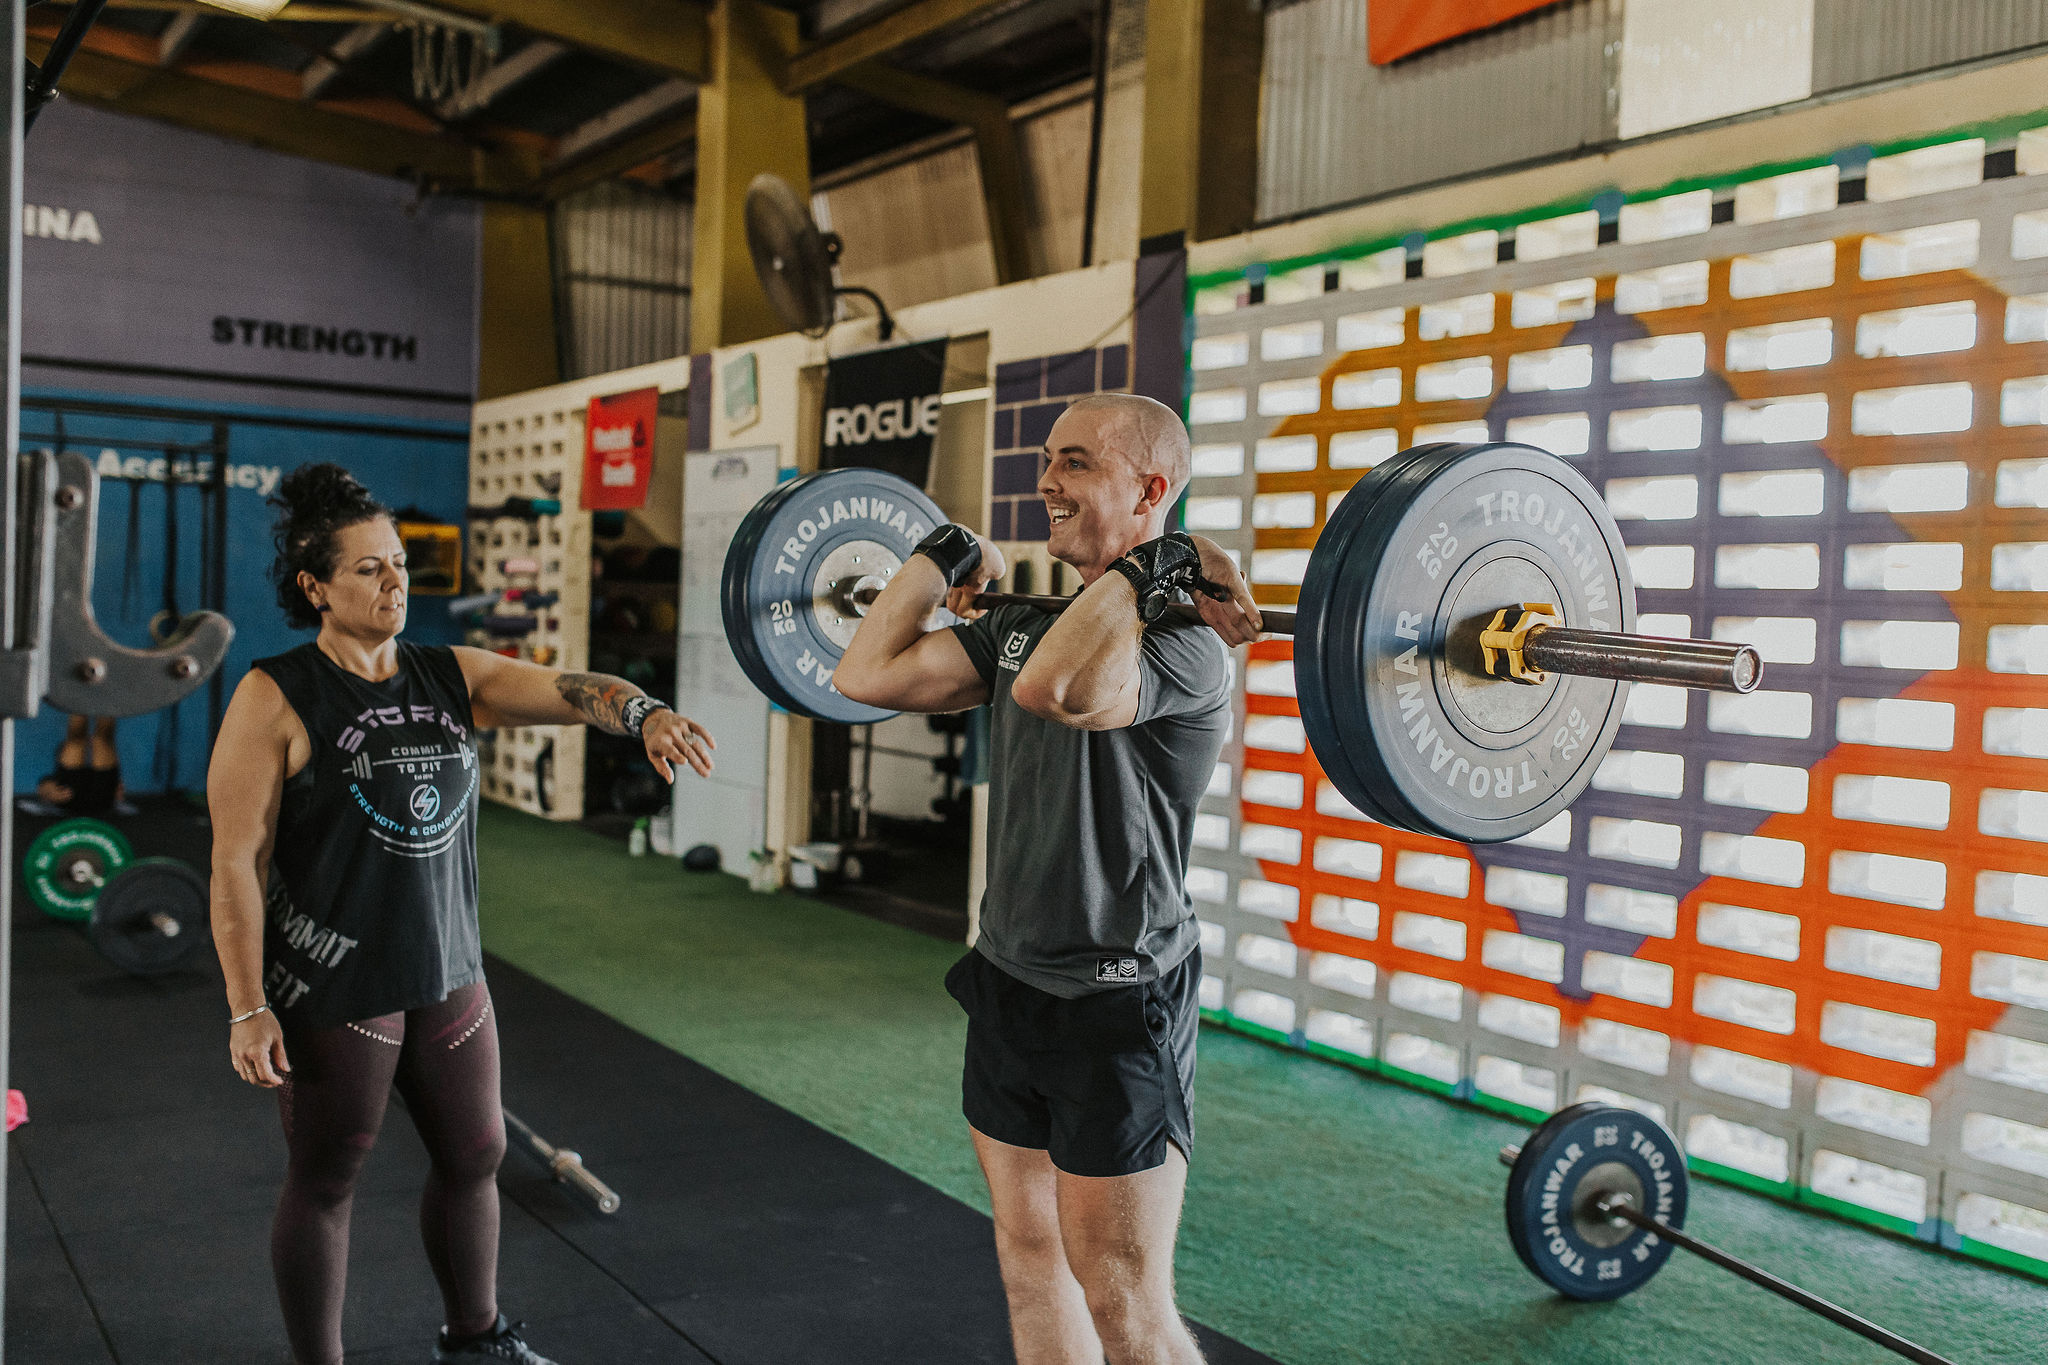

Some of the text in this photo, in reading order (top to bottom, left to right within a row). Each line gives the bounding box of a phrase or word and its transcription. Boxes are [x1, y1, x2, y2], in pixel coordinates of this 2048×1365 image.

[212, 315, 417, 361] STRENGTH
[824, 394, 940, 447] ROGUE
[774, 497, 925, 576] TROJANWAR
[1429, 521, 1458, 560] 20
[1416, 542, 1442, 580] KG
[1476, 490, 1611, 631] TROJANW
[769, 599, 793, 622] 20
[773, 619, 797, 636] KG
[1394, 609, 1537, 799] TROJANWAR
[1567, 706, 1591, 740] KG
[336, 704, 467, 754] STORM
[1553, 726, 1579, 760] 20
[391, 744, 442, 757] COMMIT
[397, 761, 442, 774] TO FIT
[349, 768, 477, 836] STRENGTH & CONDITIONING
[1541, 1142, 1585, 1277] TROJANWAR
